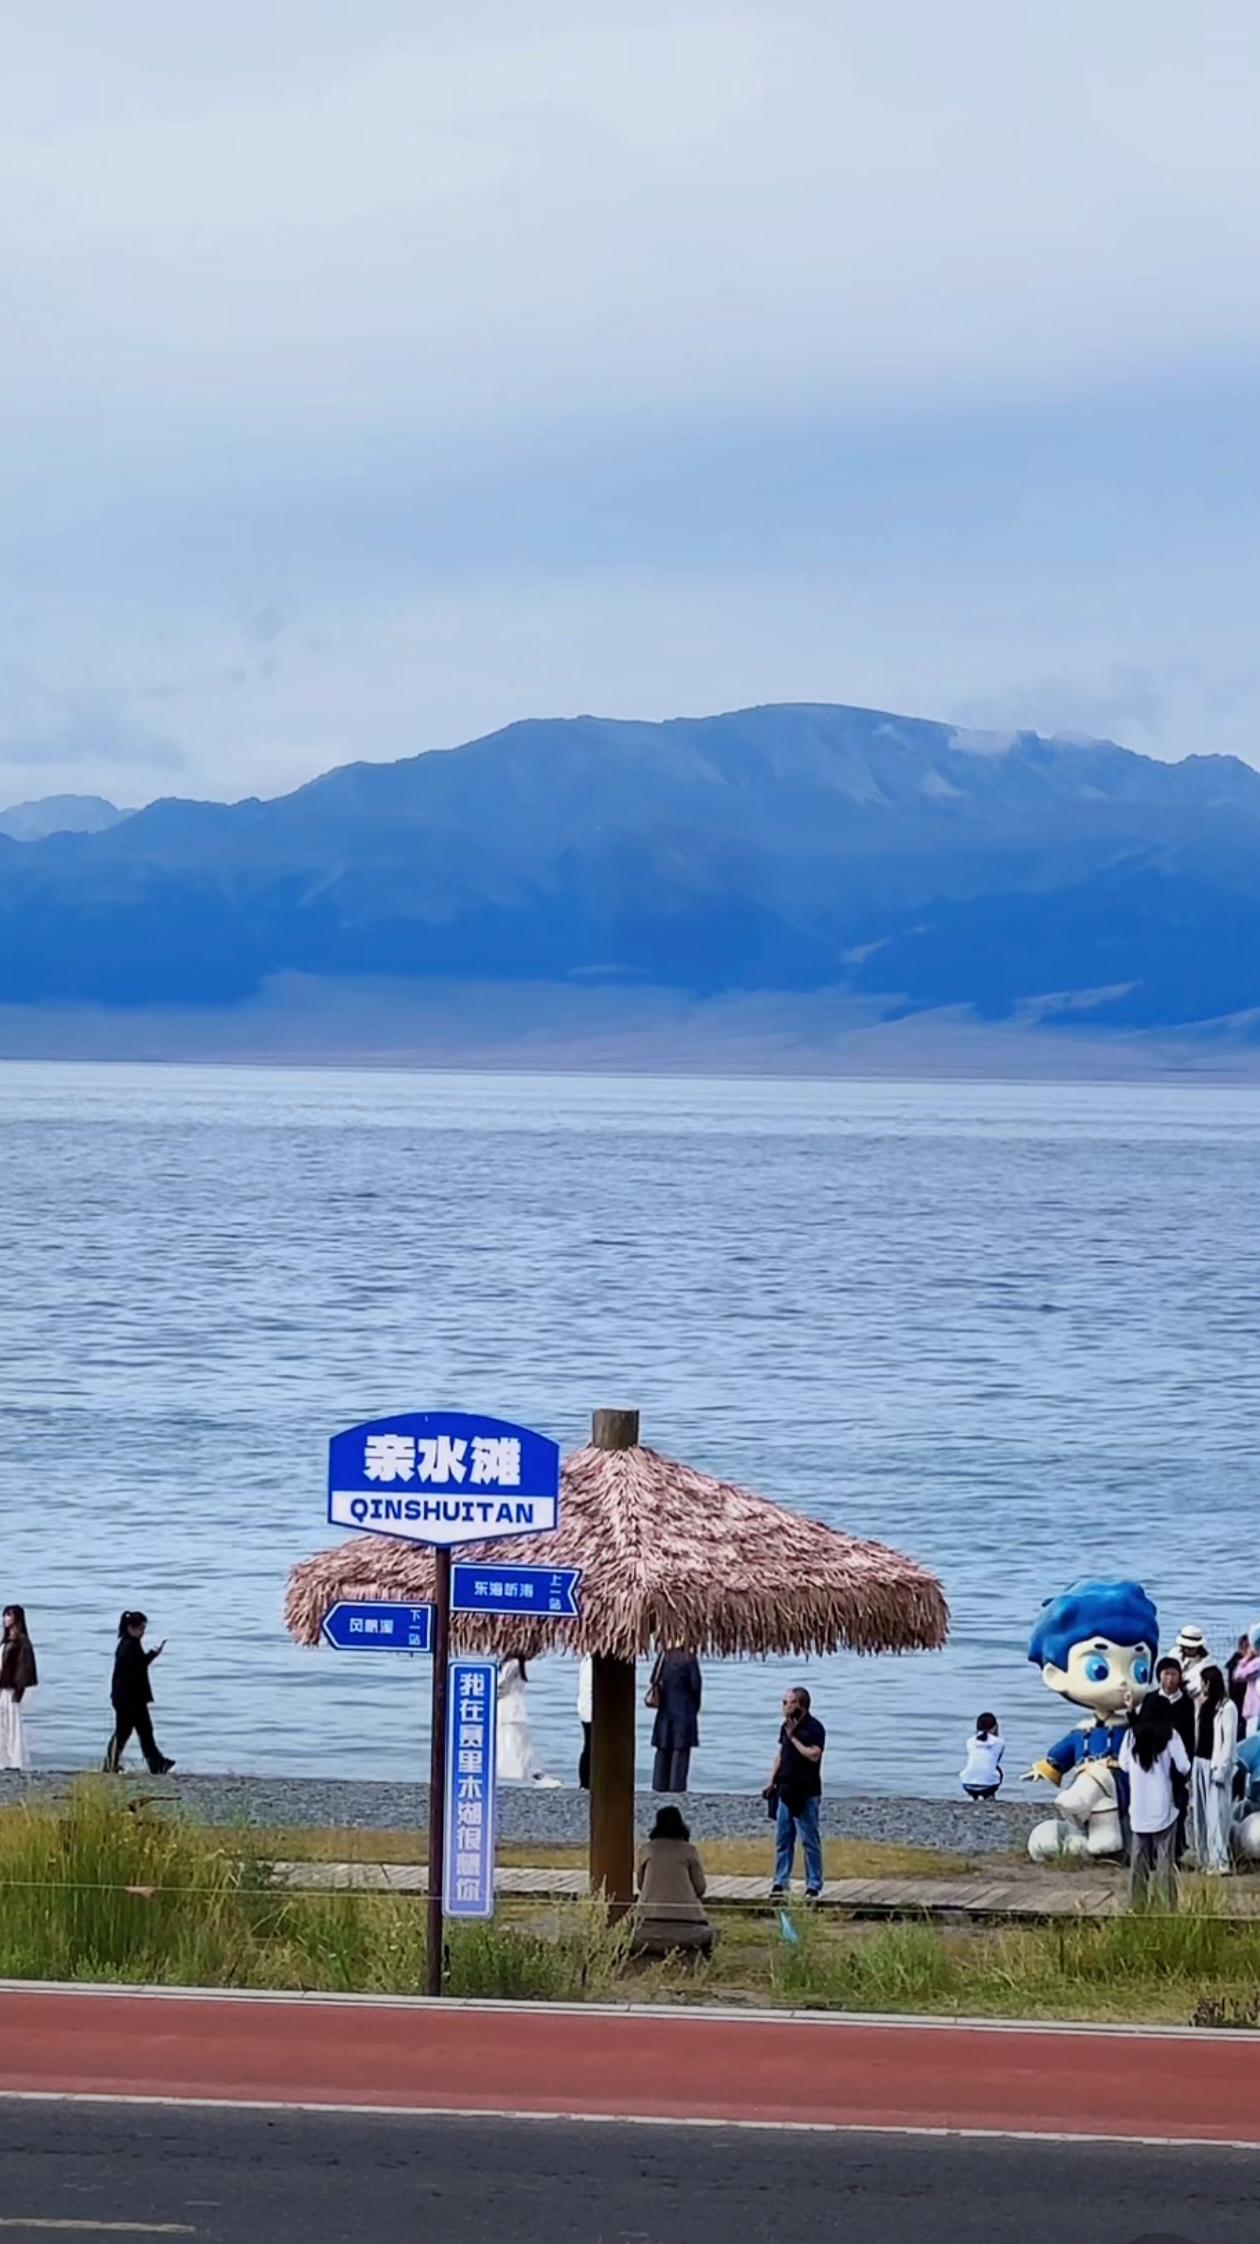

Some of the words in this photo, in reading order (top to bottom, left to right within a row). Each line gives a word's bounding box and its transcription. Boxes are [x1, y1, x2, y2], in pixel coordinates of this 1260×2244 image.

[362, 1434, 522, 1487] 亲水滩
[350, 1498, 534, 1524] QINSHUITAN
[408, 1609, 422, 1646] 下一站
